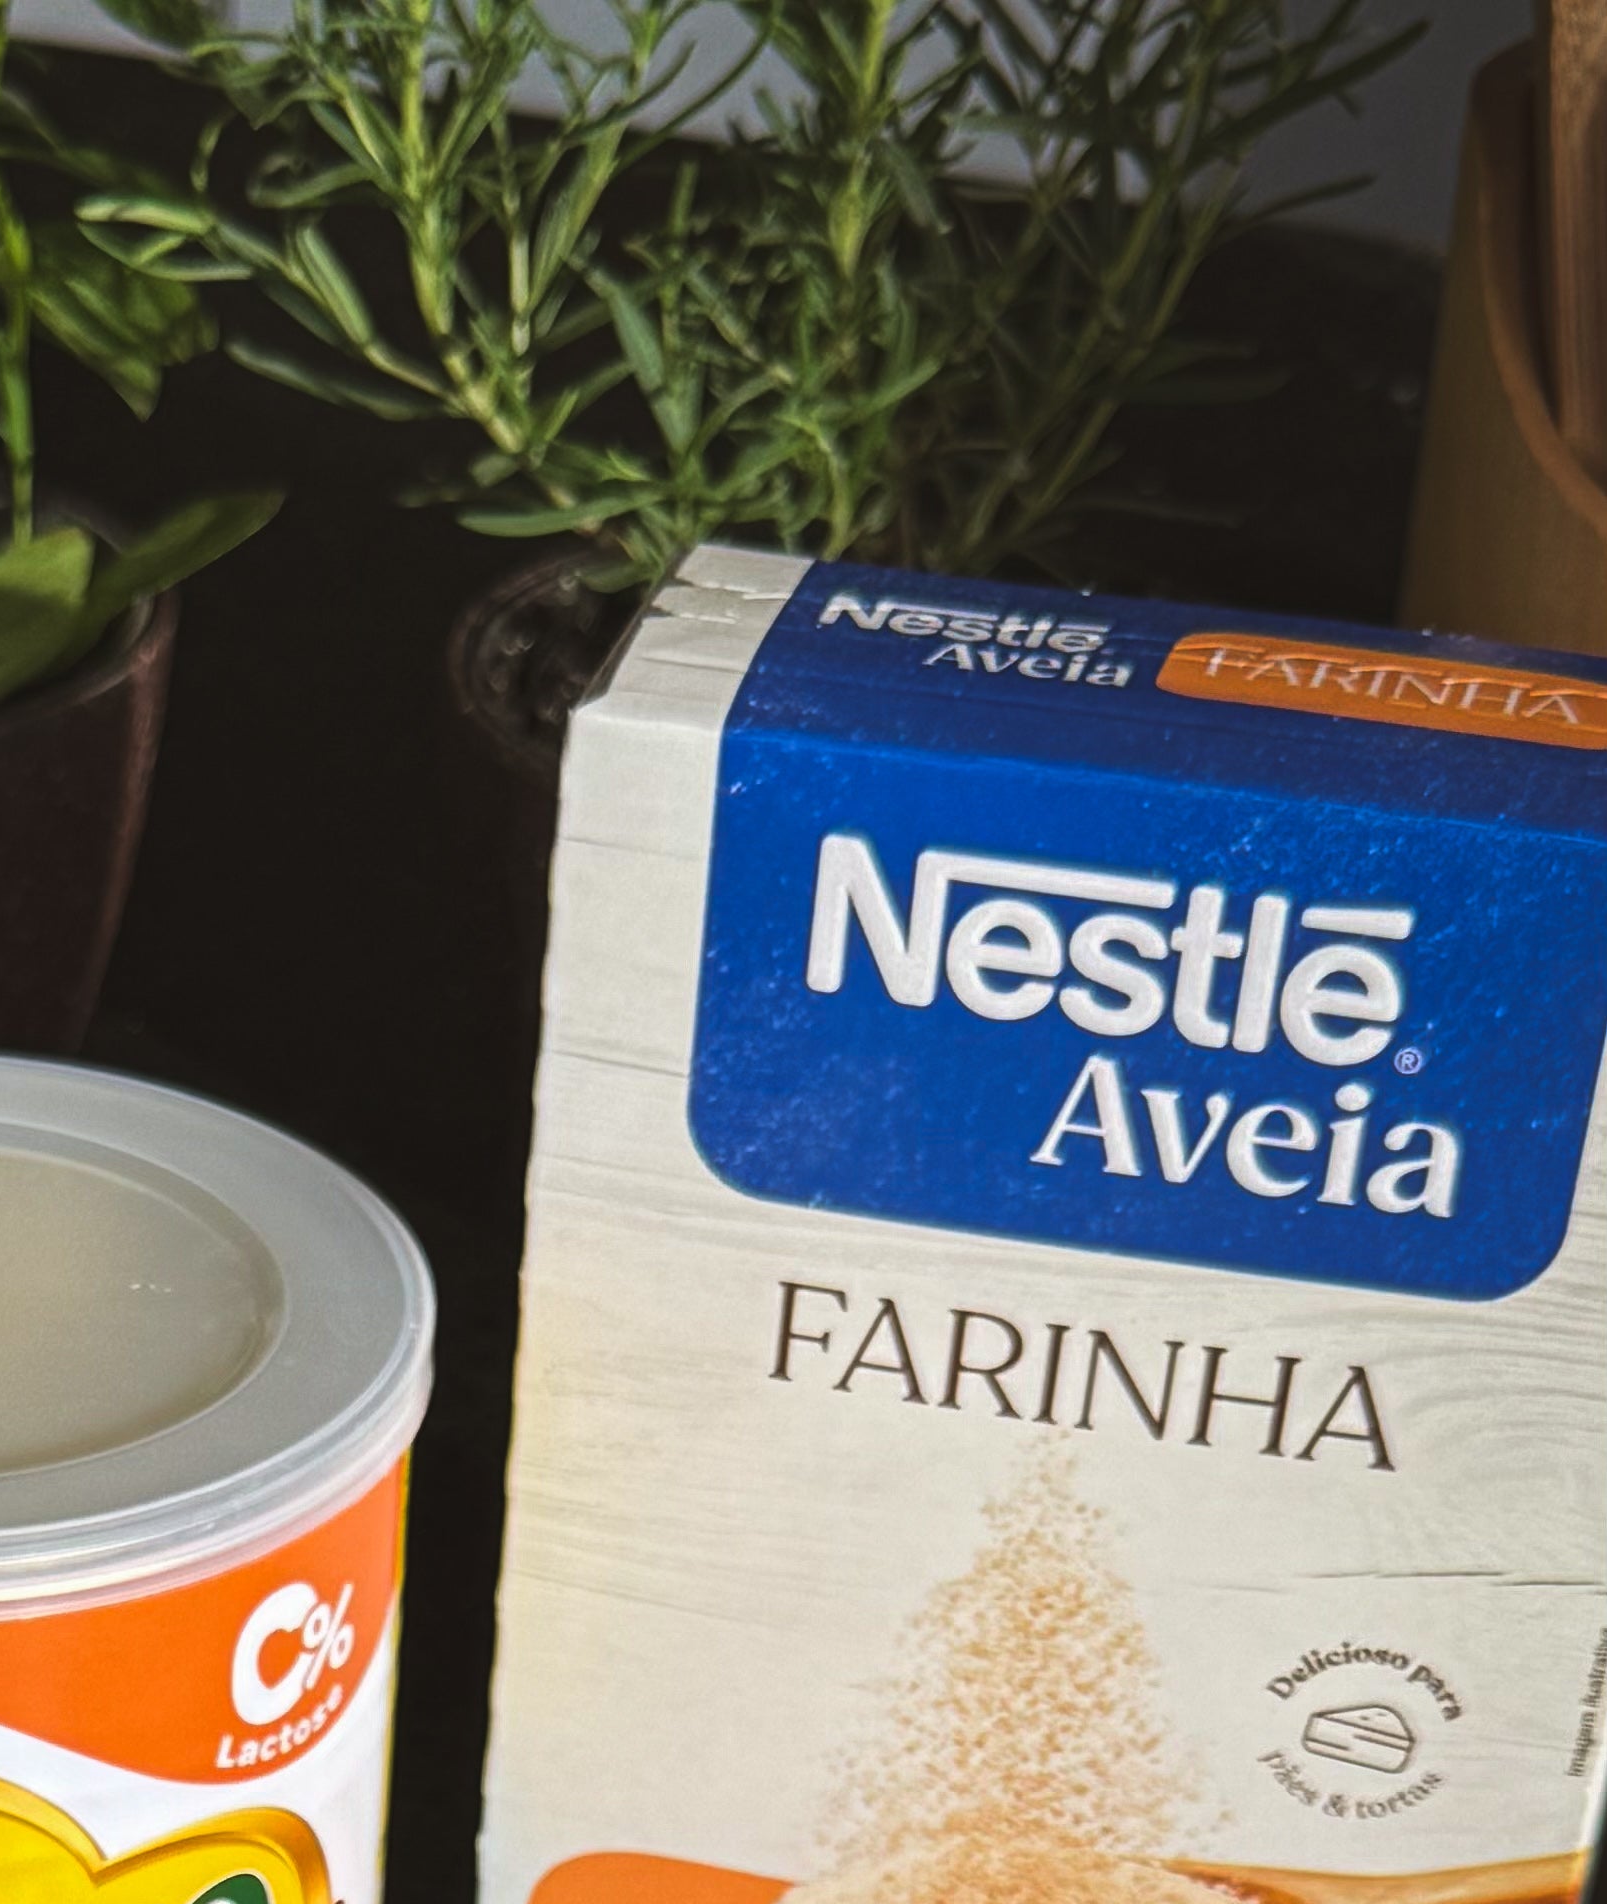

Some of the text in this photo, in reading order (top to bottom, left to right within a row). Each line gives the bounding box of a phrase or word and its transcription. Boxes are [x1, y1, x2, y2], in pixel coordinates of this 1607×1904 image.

[818, 594, 1111, 655] Nestlé
[923, 643, 1134, 689] Aveia
[1204, 647, 1583, 726] FARINHA
[805, 832, 1416, 1068] Nestlé
[1030, 1054, 1460, 1220] Aveia
[767, 1279, 1398, 1473] FARINHA
[1265, 1641, 1462, 1722] Delicioso para
[215, 1684, 344, 1769] Lactose
[1322, 1794, 1346, 1818] &
[1353, 1770, 1446, 1819] tortas
